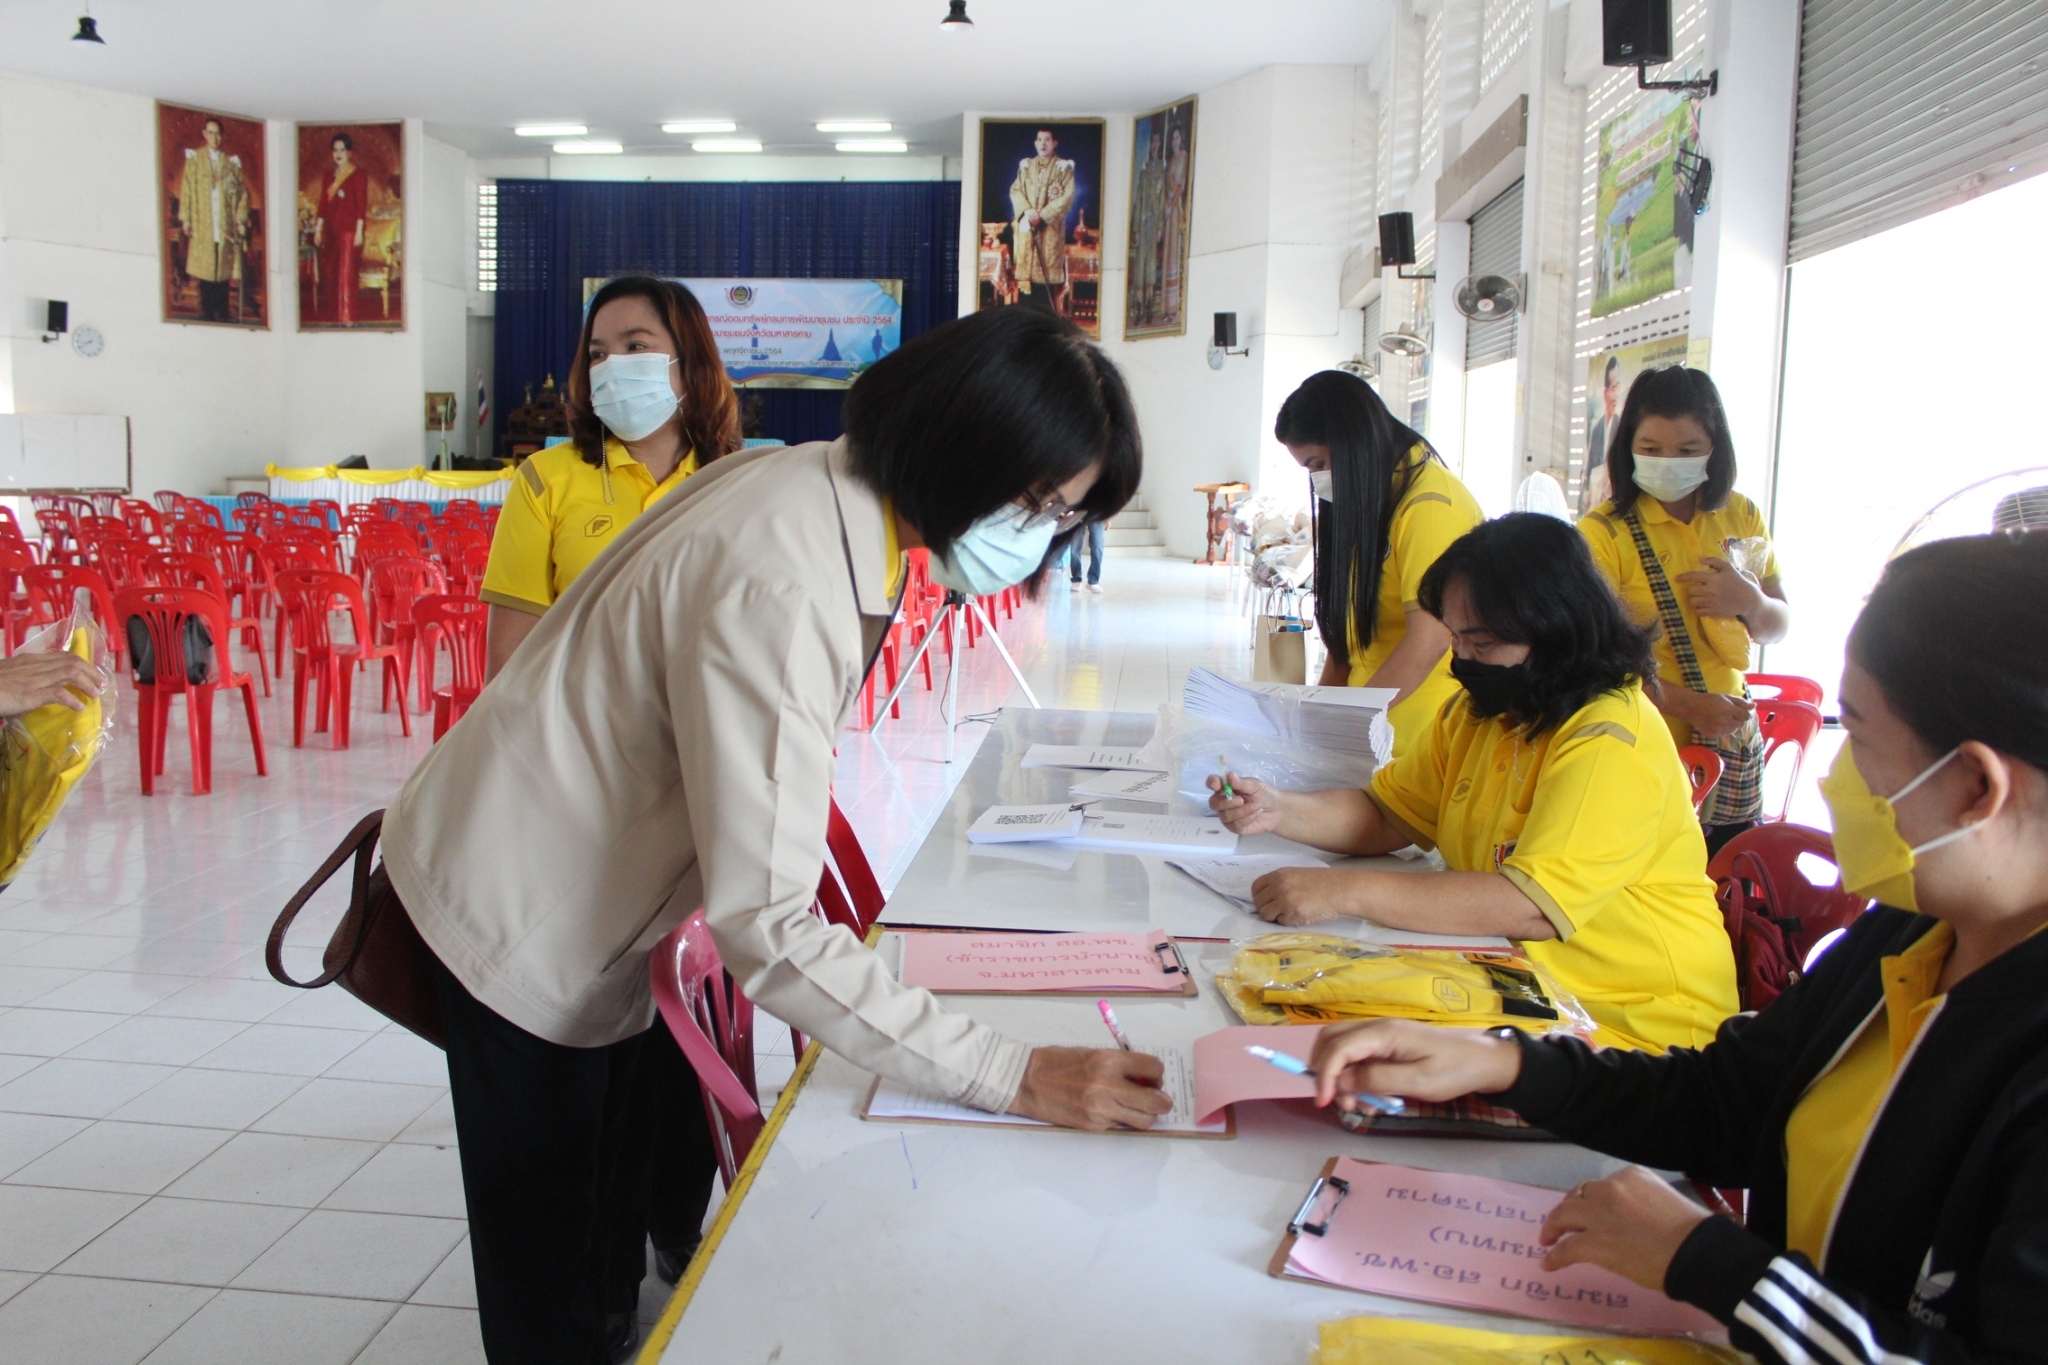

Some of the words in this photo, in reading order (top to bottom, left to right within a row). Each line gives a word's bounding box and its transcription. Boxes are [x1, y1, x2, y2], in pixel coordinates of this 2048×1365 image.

[843, 313, 869, 324] ประจำปี
[872, 315, 893, 324] 2564
[764, 347, 782, 355] 2564
[970, 939, 1046, 949] สมาชิก
[1056, 938, 1135, 948] สอ.พช.
[977, 966, 1141, 979] จ.มหาสารคาม
[1385, 1187, 1548, 1226] าสารคาม
[1428, 1226, 1549, 1261] สมทบ)
[1353, 1251, 1482, 1286] สอ.พช.
[1499, 1276, 1630, 1310] สมาชิก
